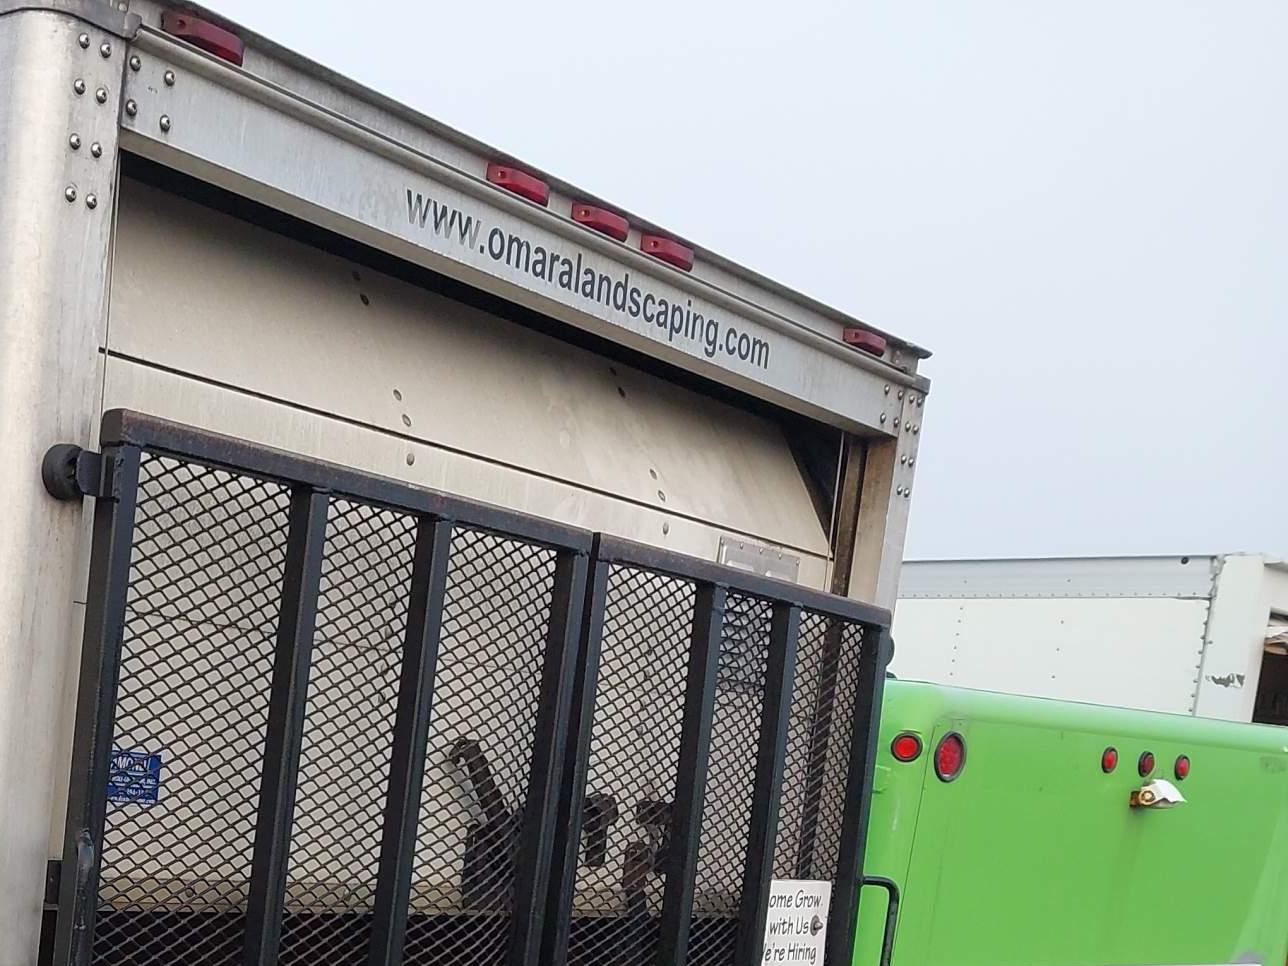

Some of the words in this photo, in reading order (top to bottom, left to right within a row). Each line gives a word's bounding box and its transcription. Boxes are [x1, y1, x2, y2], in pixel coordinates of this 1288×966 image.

[405, 188, 770, 370] www.omaralandscaping.com
[768, 893, 793, 909] ome
[794, 889, 822, 909] Grow
[769, 916, 794, 935] with
[795, 916, 810, 935] Us
[762, 942, 786, 962] e're
[787, 942, 817, 966] Hiring
